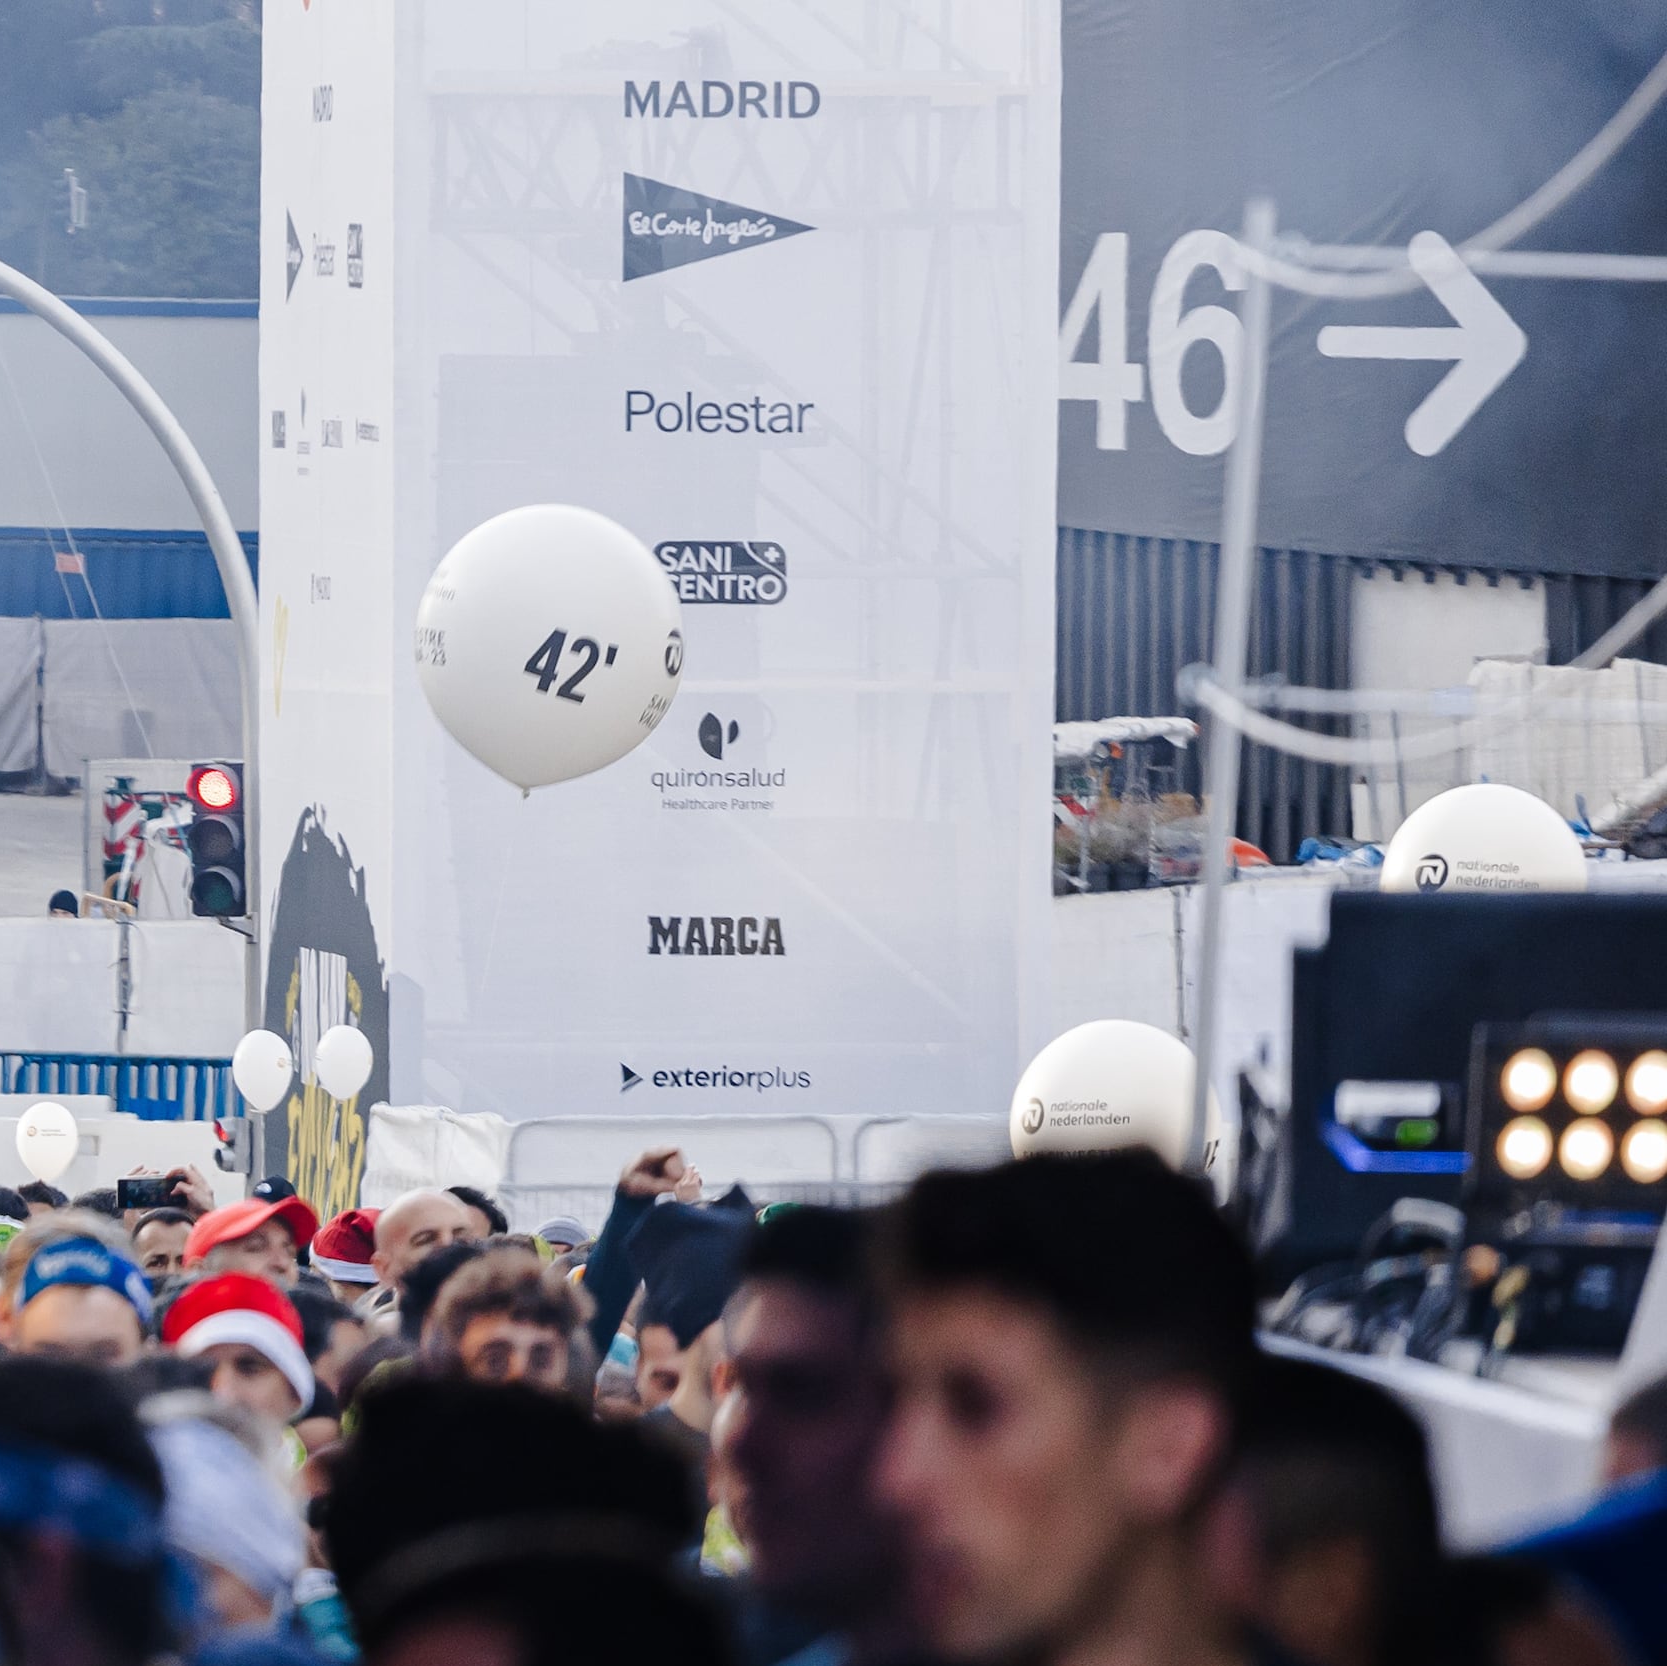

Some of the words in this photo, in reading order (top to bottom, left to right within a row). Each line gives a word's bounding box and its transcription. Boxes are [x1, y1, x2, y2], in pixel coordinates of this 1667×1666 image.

[623, 79, 822, 120] MADRID
[651, 212, 702, 237] Corte
[625, 389, 815, 435] Polestar
[661, 545, 732, 573] SANI
[523, 626, 620, 705] 42'
[662, 798, 728, 811] Healthcare
[731, 798, 775, 811] Partner
[1456, 859, 1520, 873] nationale
[1455, 875, 1540, 890] nederlanden
[647, 915, 787, 956] MARCA
[652, 1064, 812, 1094] exteriorplus
[1050, 1098, 1108, 1112] nationale
[1050, 1113, 1131, 1127] nederlanden
